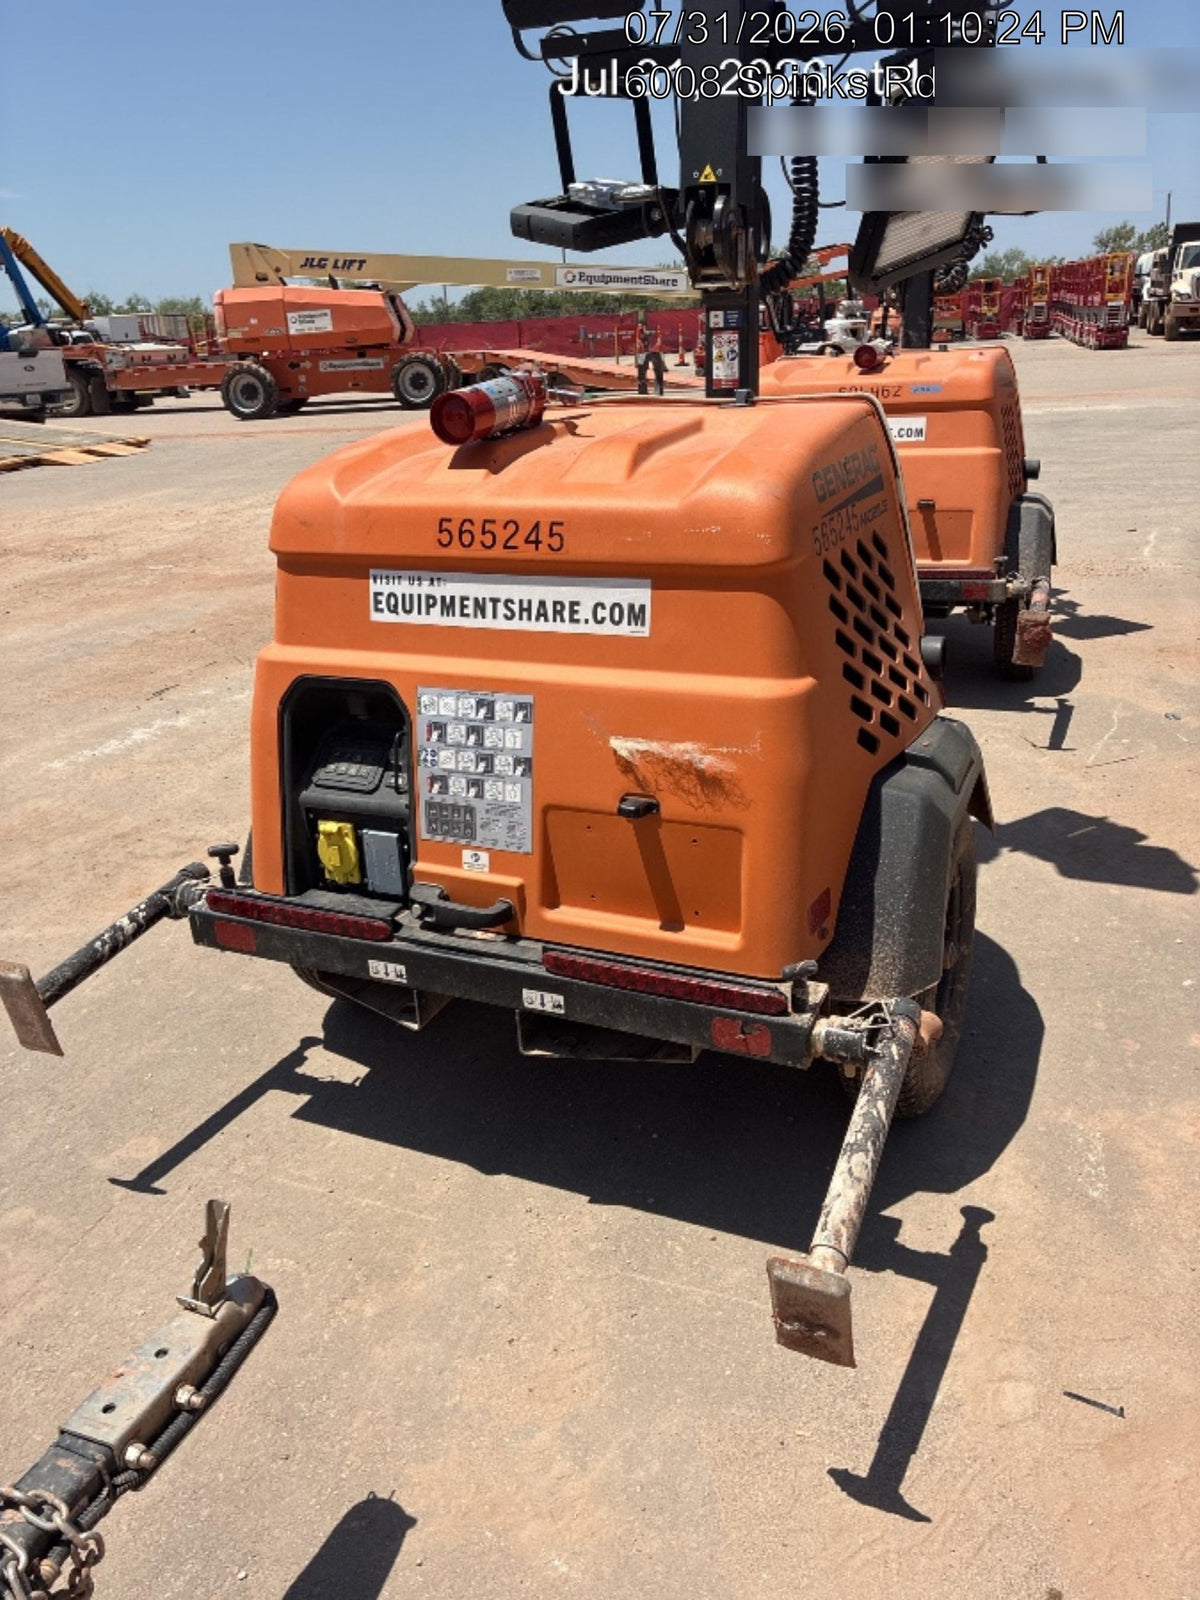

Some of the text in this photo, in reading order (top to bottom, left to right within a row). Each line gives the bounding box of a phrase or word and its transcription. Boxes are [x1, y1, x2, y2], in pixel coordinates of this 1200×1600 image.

[300, 257, 367, 271] JLG LIFT
[577, 271, 678, 287] EquipmentShare
[437, 517, 565, 552] 565245
[812, 503, 860, 556] 565245
[372, 573, 402, 586] VISIT
[408, 575, 423, 587] US
[373, 590, 647, 628] EQUIPMENTSHARE.COM
